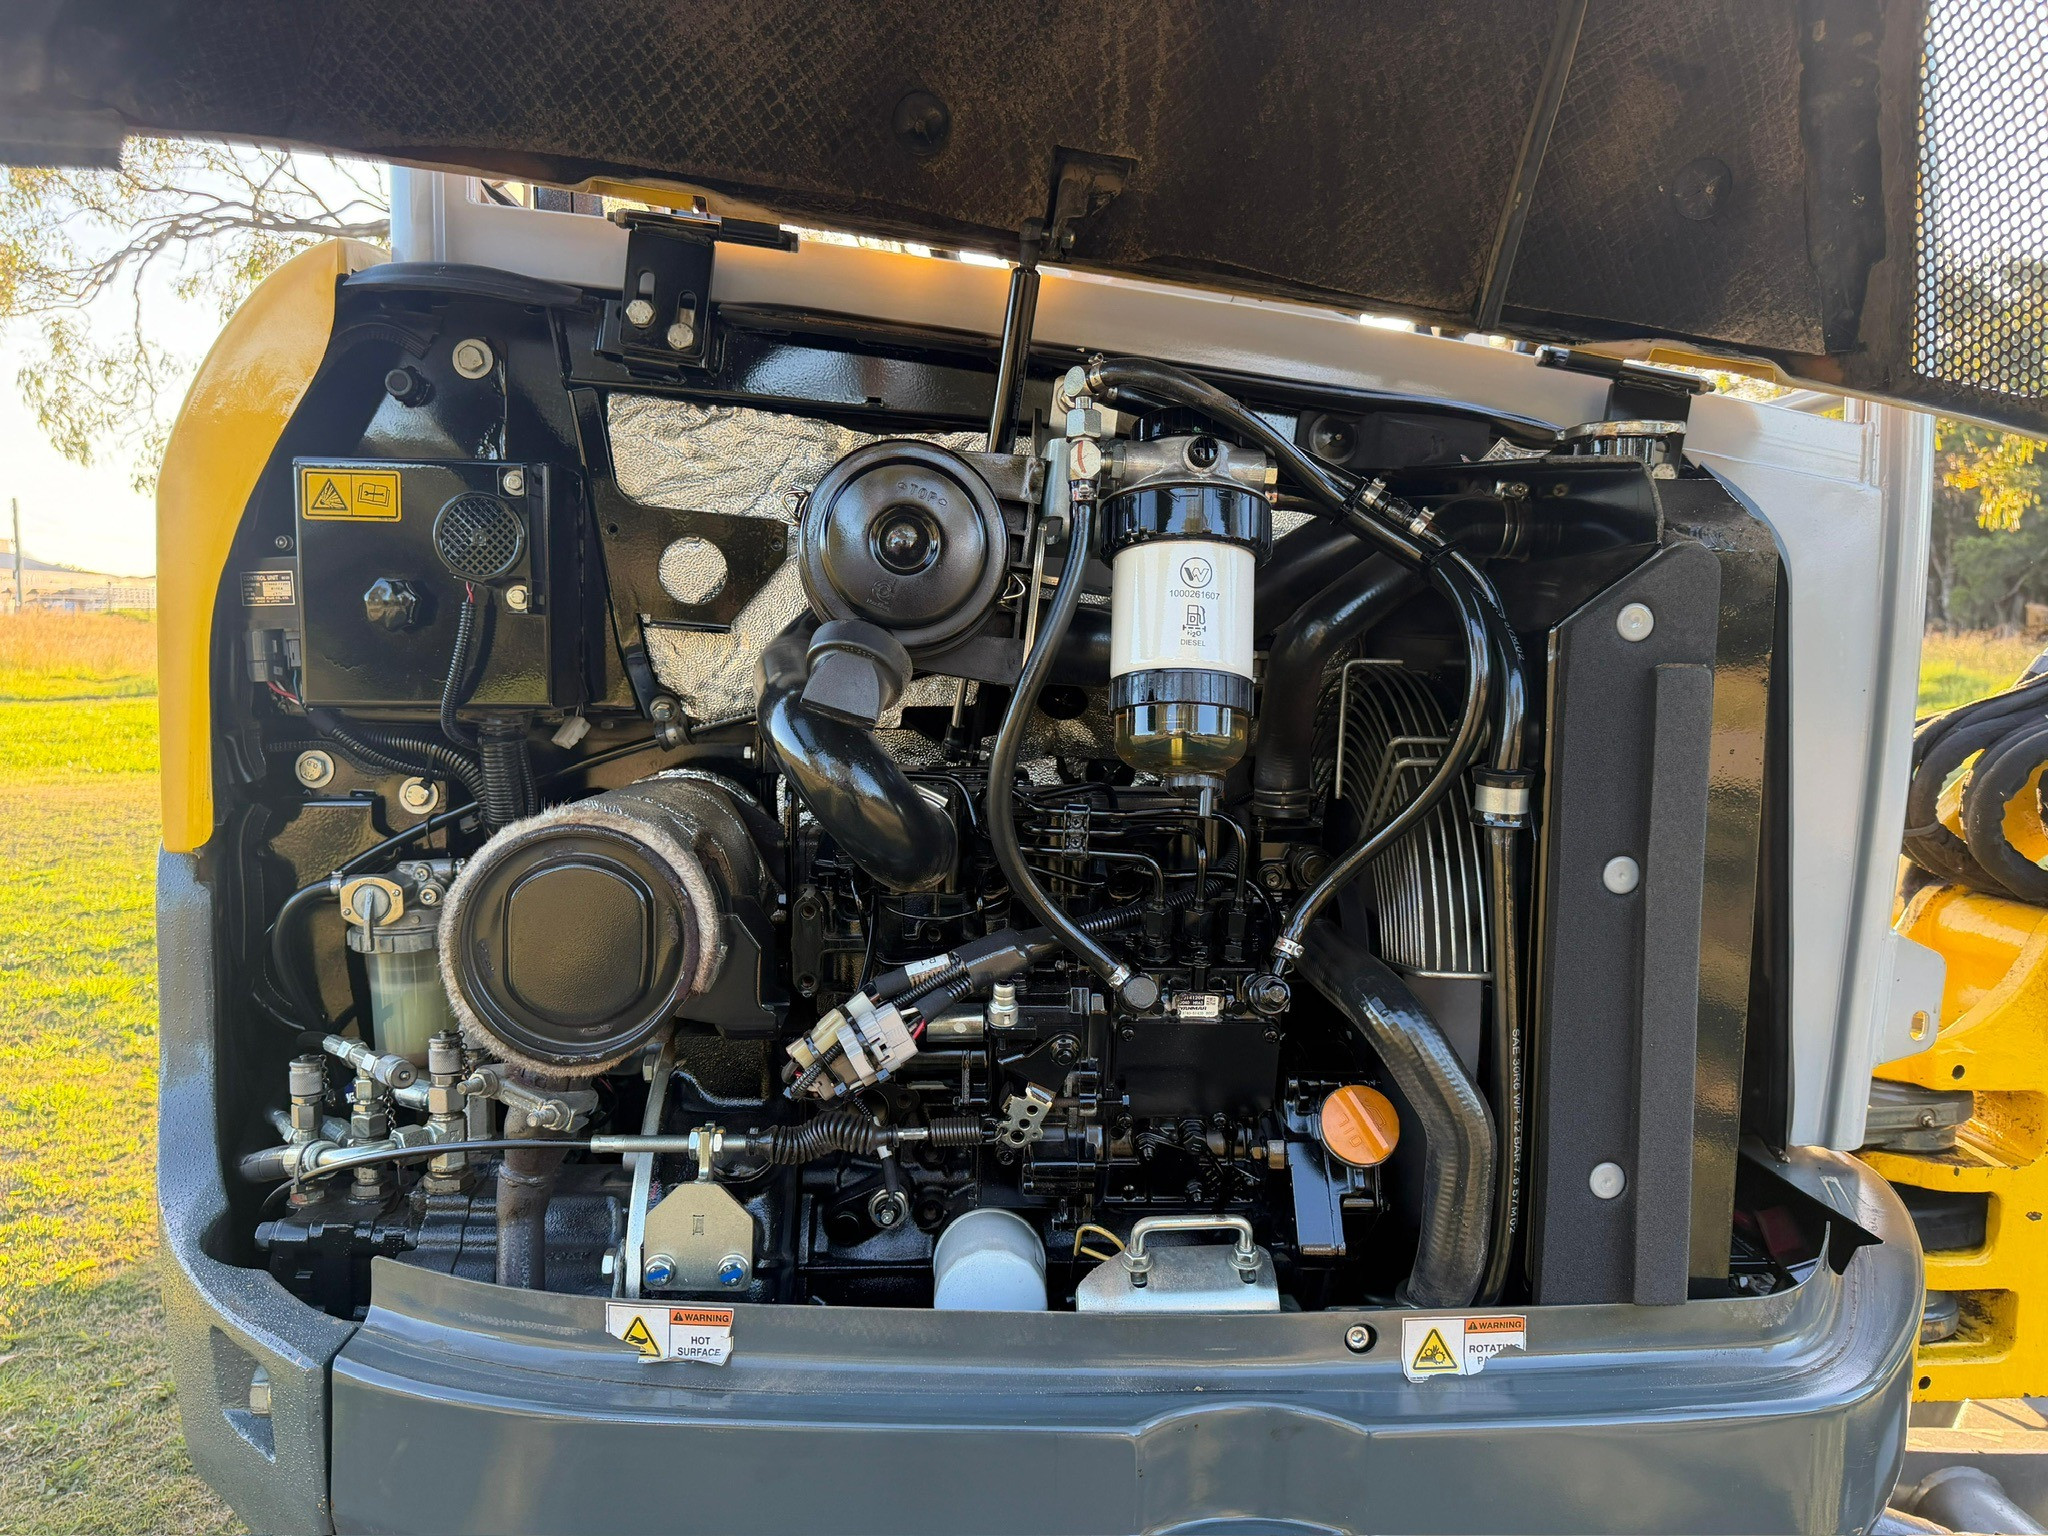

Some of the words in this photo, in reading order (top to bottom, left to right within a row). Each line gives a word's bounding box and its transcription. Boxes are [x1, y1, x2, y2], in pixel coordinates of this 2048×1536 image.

[910, 483, 937, 502] TOP
[1169, 589, 1221, 600] 1000261607
[1180, 639, 1206, 647] DIESEL
[1512, 1028, 1520, 1055] SAE
[1512, 1058, 1521, 1090] 30R6
[1513, 1093, 1522, 1114] WP
[1339, 1113, 1362, 1148] OIL
[1513, 1119, 1521, 1133] 12
[1513, 1137, 1521, 1163] BAR
[684, 1313, 730, 1323] WARNING
[1478, 1320, 1522, 1330] WARNING
[690, 1336, 711, 1345] HOT
[677, 1346, 721, 1357] SURFACE
[1469, 1343, 1521, 1353] ROTAT
